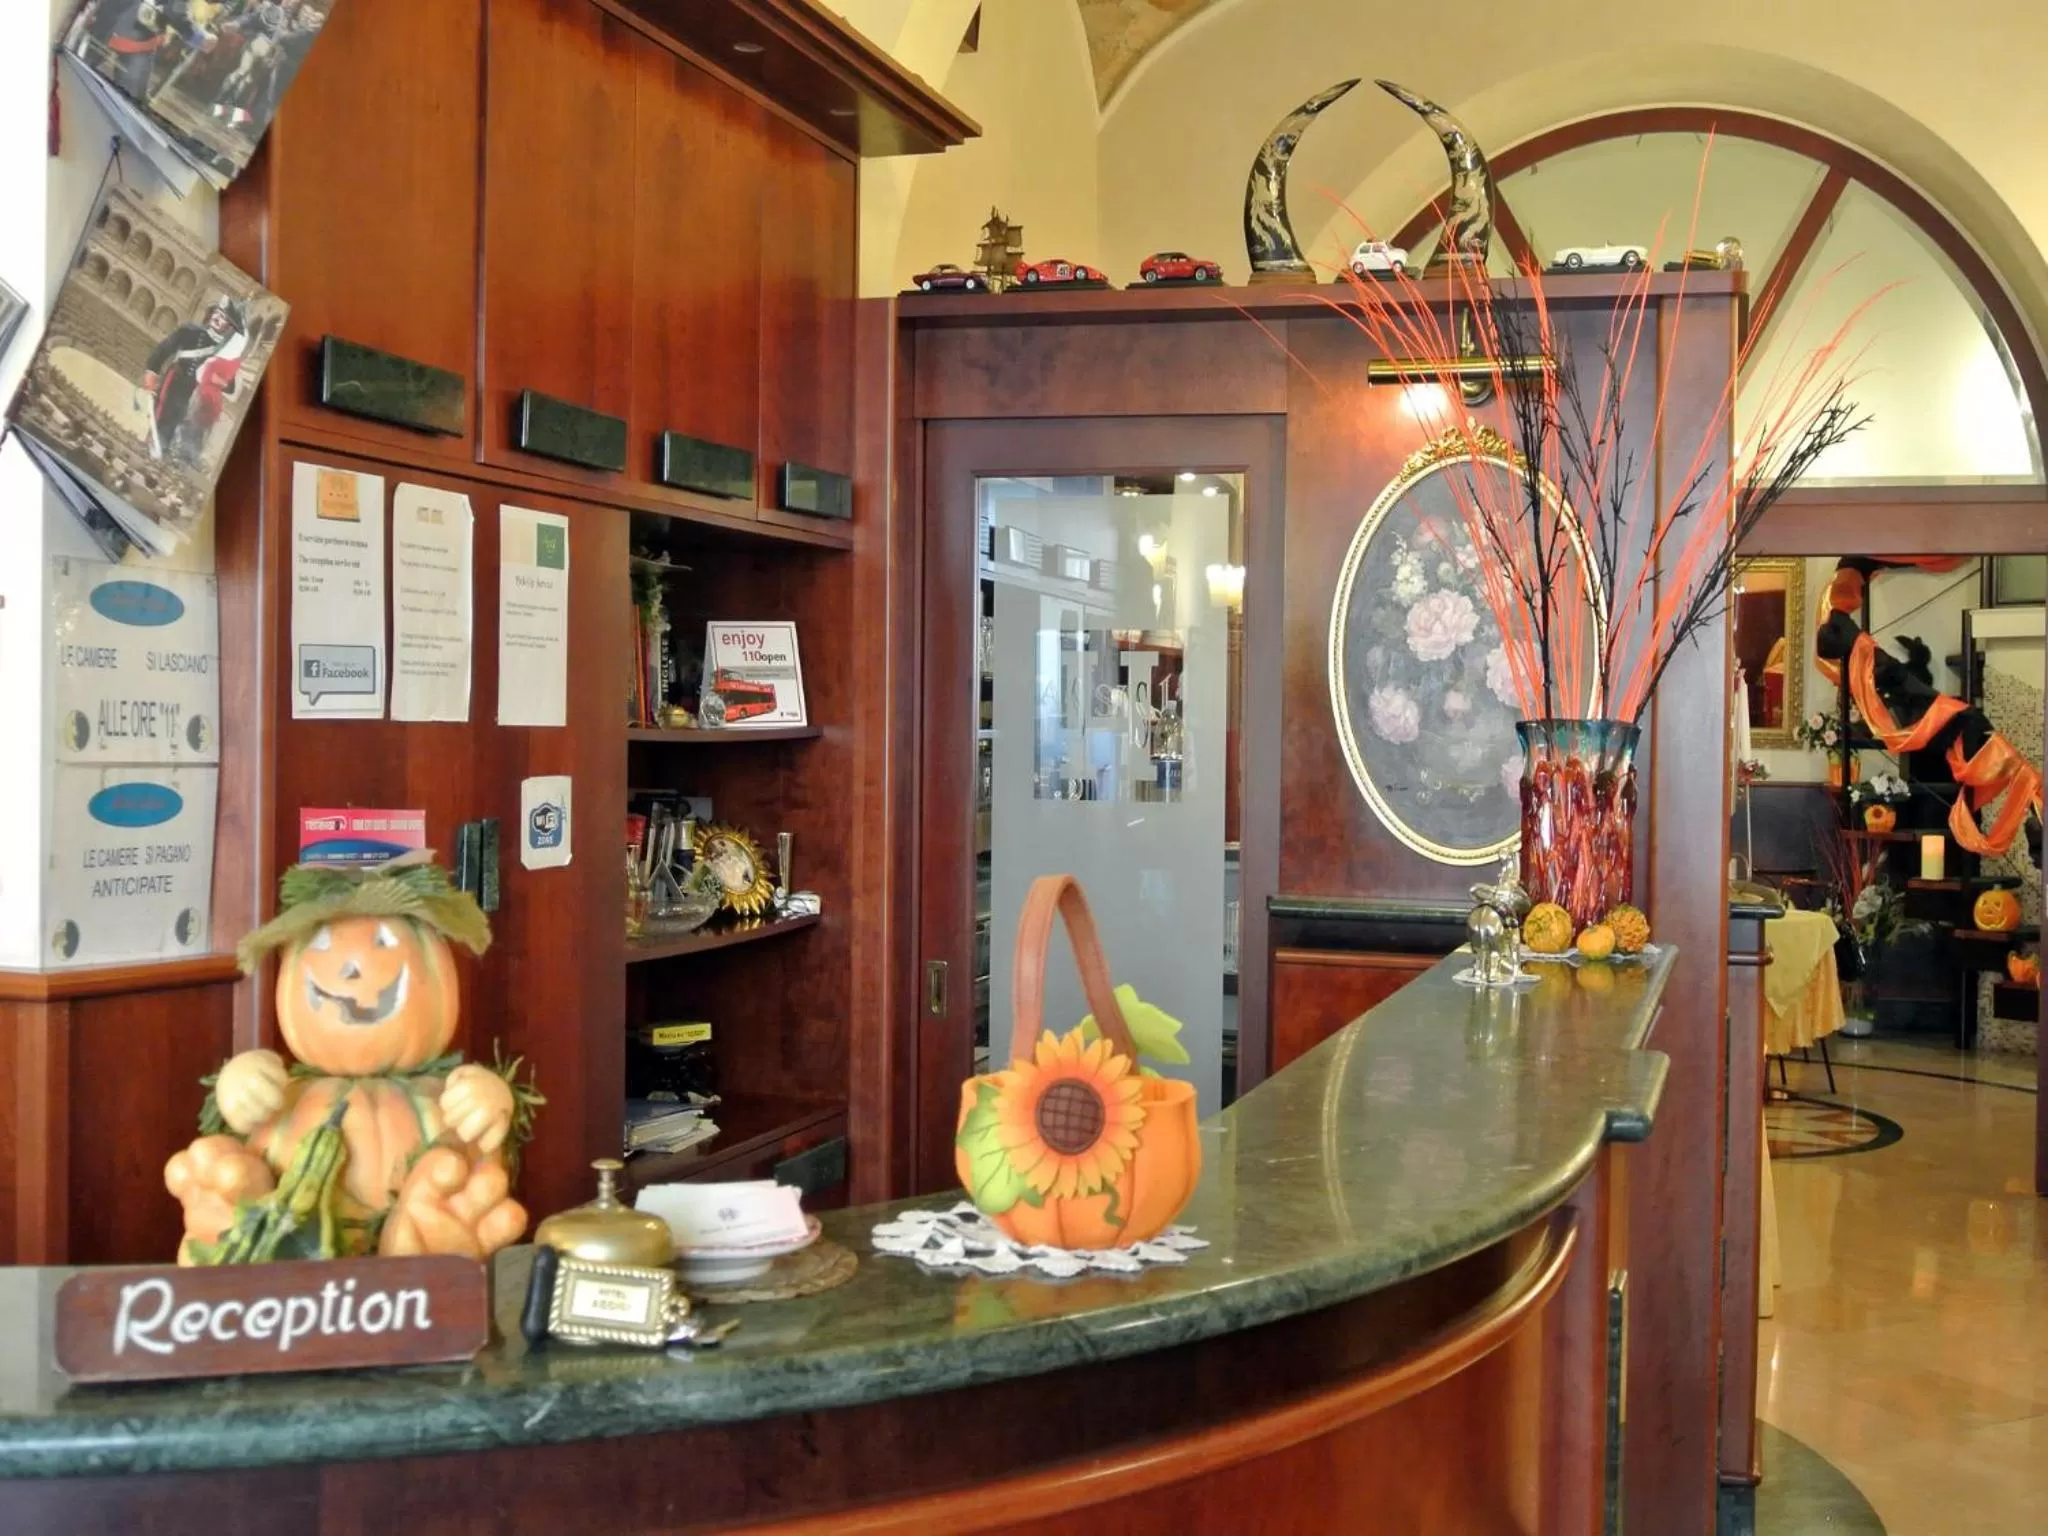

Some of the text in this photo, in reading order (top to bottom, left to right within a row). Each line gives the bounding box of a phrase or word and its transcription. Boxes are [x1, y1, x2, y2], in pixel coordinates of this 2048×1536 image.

[722, 630, 765, 649] enjoy
[61, 645, 208, 674] LE CAMERE SI LASCIANO
[661, 639, 669, 693] INGLESE
[743, 651, 787, 664] 110open
[322, 667, 369, 679] Facebook
[98, 700, 128, 737] ALLE
[131, 701, 156, 738] ORE
[82, 849, 96, 869] LE
[98, 847, 139, 868] CAMERE
[92, 875, 174, 898] ANTICIPATE
[113, 1276, 432, 1356] Reception
